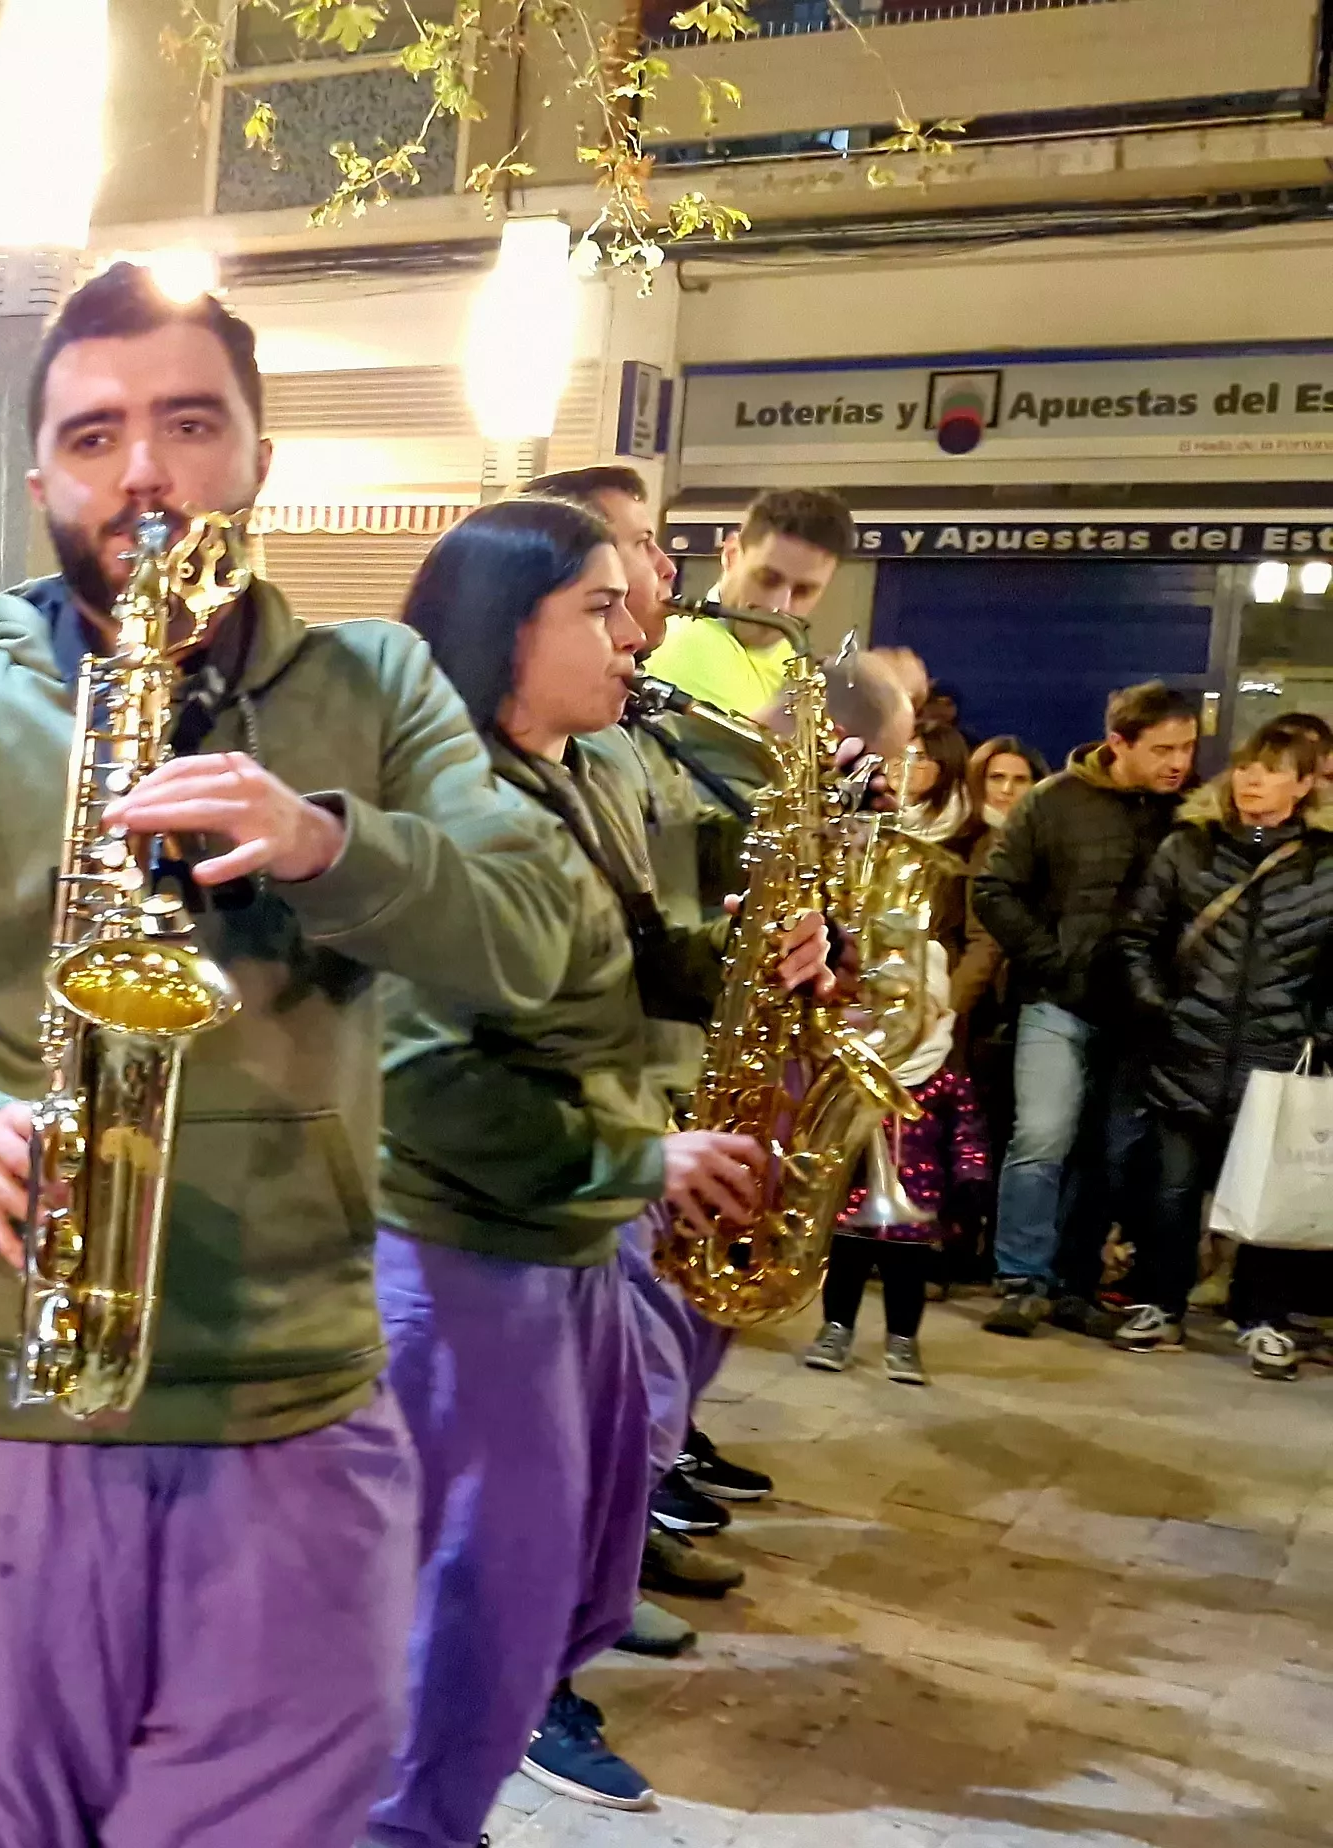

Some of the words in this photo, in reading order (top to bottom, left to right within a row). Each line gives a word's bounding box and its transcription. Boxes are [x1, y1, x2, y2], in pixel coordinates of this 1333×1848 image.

[735, 396, 884, 427] Loterías
[895, 402, 918, 430] y
[1008, 388, 1198, 428] Apuestas
[1214, 382, 1280, 416] del
[900, 530, 925, 553] y
[935, 526, 1151, 553] Apuestas
[1170, 525, 1244, 550] del
